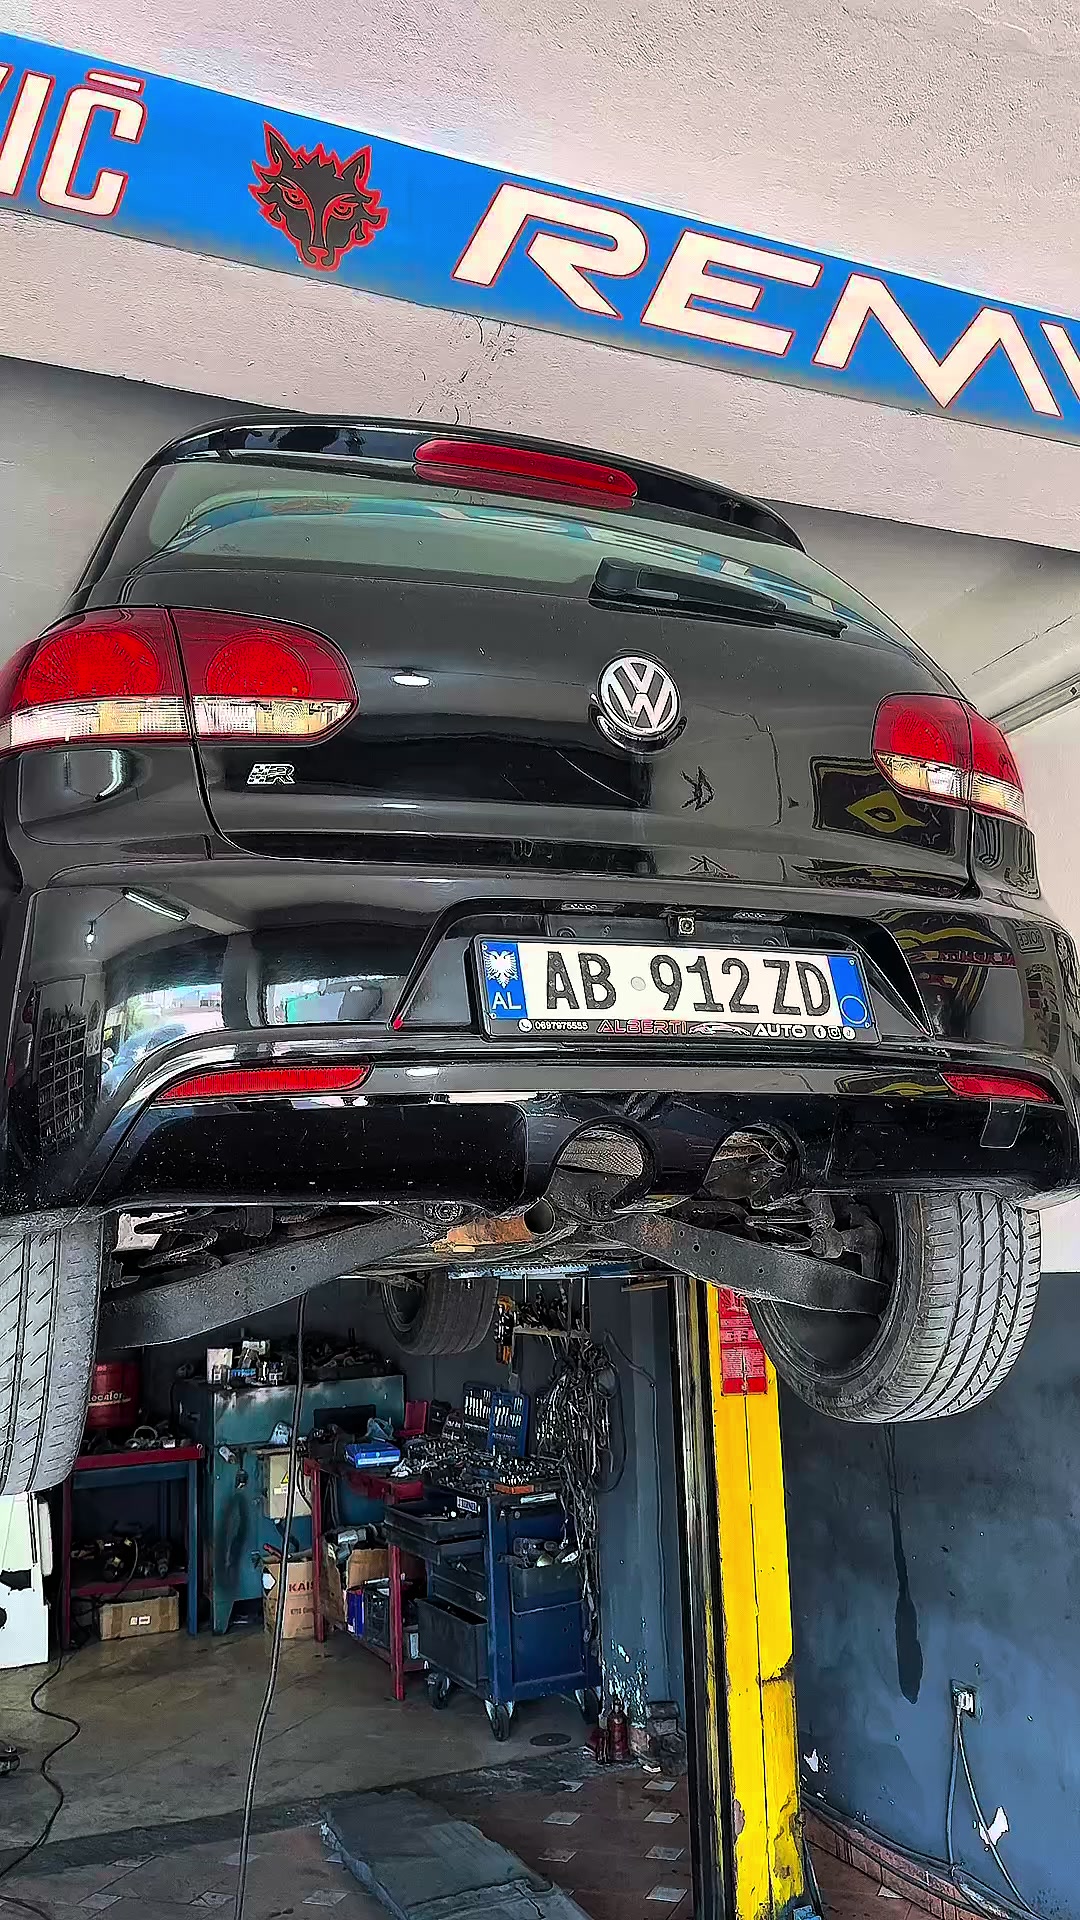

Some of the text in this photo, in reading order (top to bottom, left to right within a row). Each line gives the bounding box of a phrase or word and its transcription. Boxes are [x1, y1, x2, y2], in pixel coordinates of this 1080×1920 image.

[0, 62, 147, 218] IČ
[491, 991, 522, 1010] AL
[547, 951, 831, 1016] AB 912 ZD
[597, 1019, 807, 1038] ALBERTI AUTO
